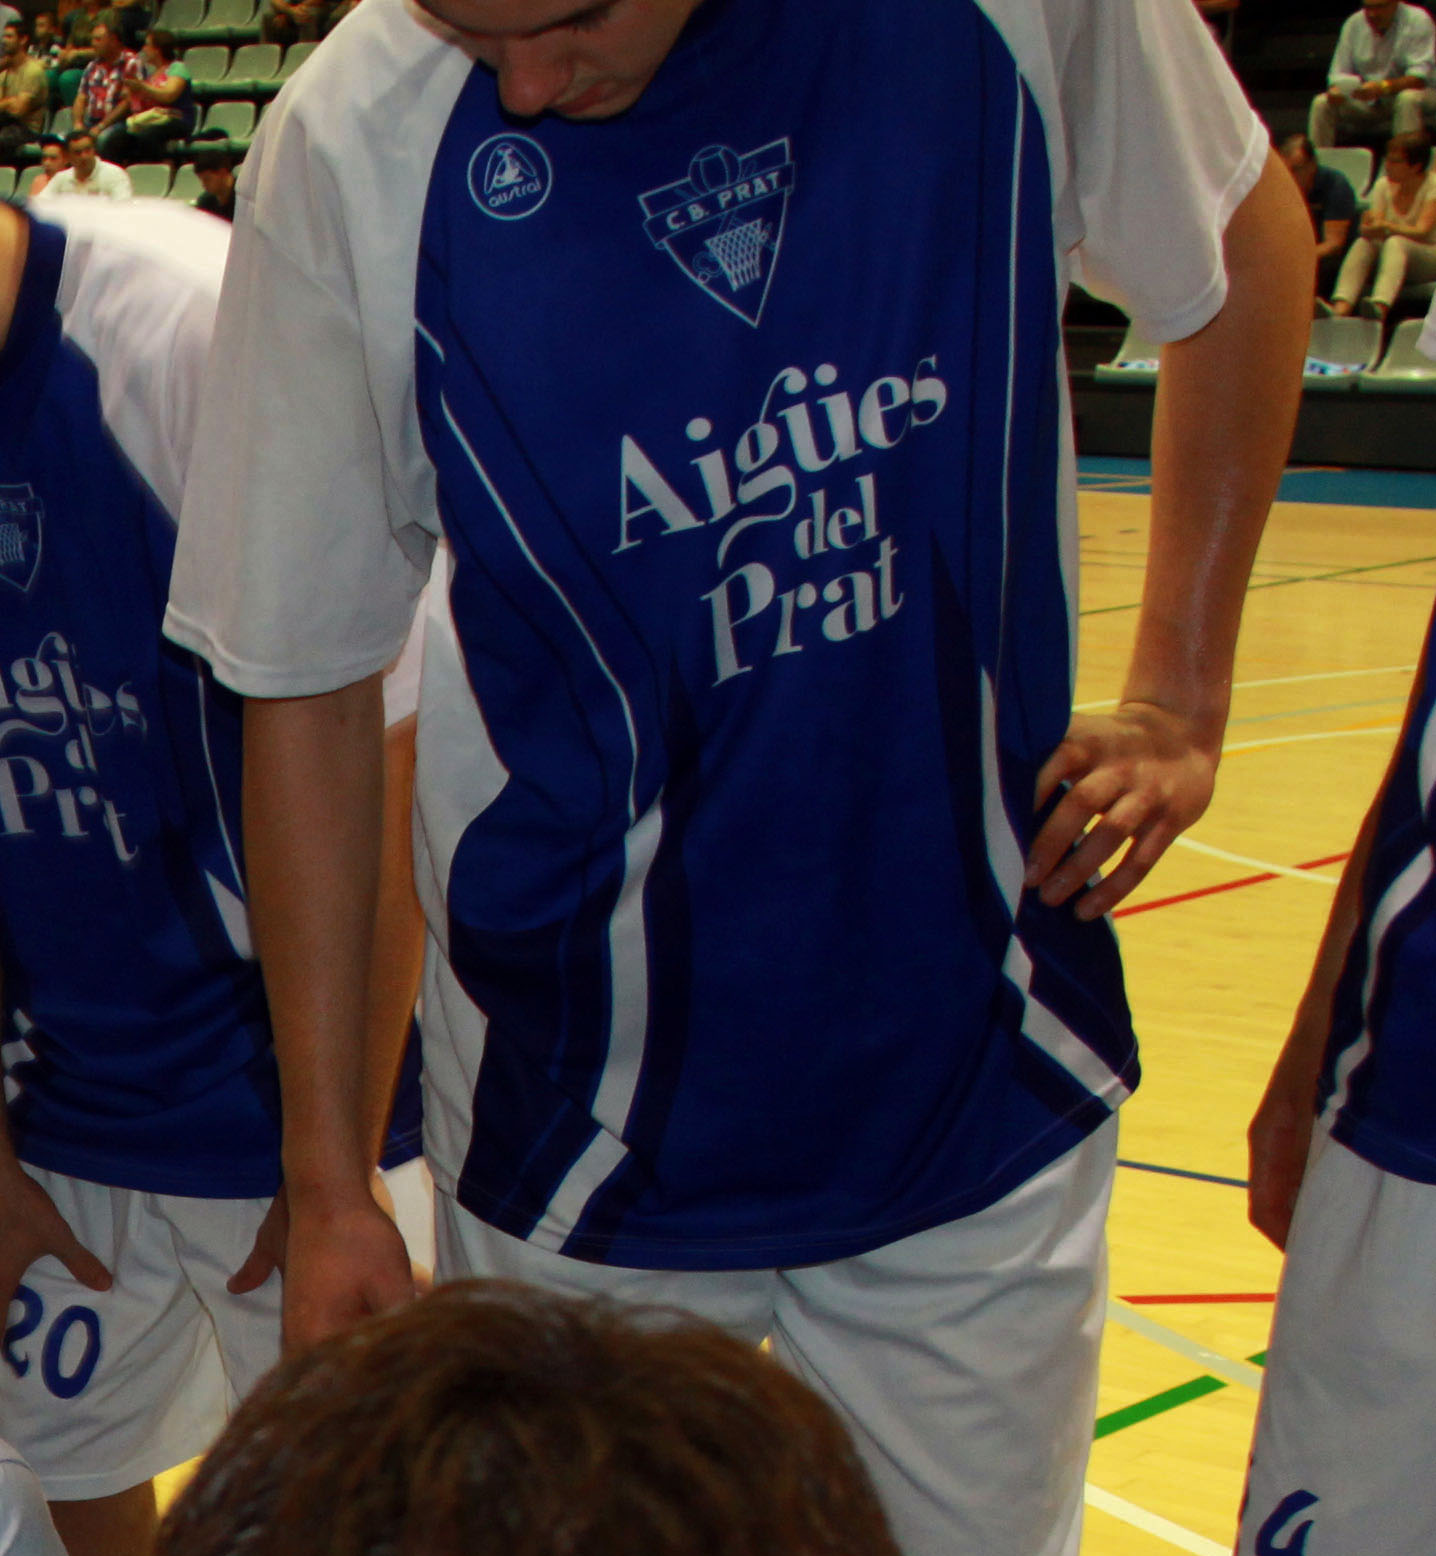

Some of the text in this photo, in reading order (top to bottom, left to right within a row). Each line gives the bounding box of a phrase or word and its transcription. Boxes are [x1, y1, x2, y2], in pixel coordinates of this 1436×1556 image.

[716, 171, 780, 210] PRAT
[610, 355, 948, 570] Aigües
[793, 472, 881, 562] del
[699, 540, 905, 688] Prat
[0, 1284, 102, 1400] 20
